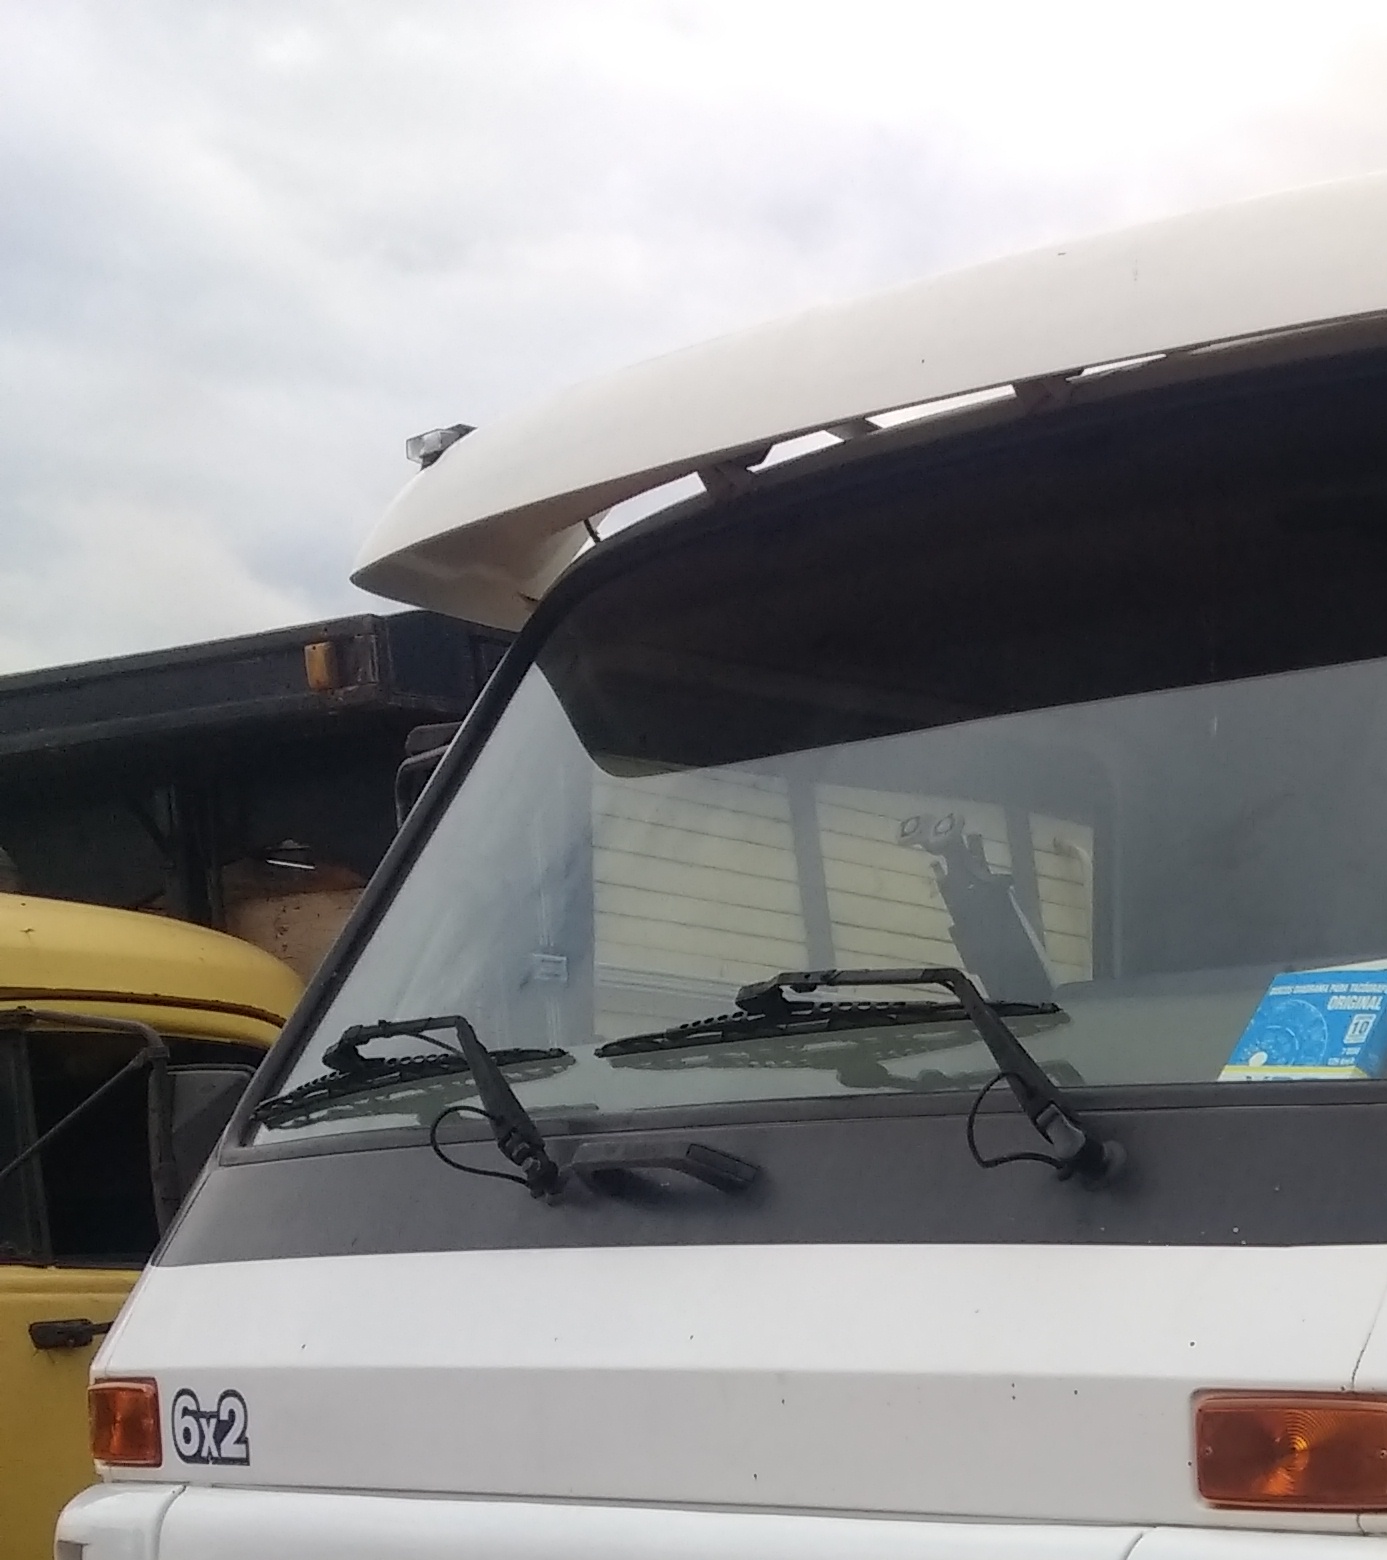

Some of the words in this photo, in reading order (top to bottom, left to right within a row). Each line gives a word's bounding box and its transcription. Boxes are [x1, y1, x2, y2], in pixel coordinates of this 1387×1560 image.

[1327, 995, 1383, 1011] ORIGINAL
[1351, 1020, 1370, 1035] 10
[172, 1388, 250, 1466] 6x2
